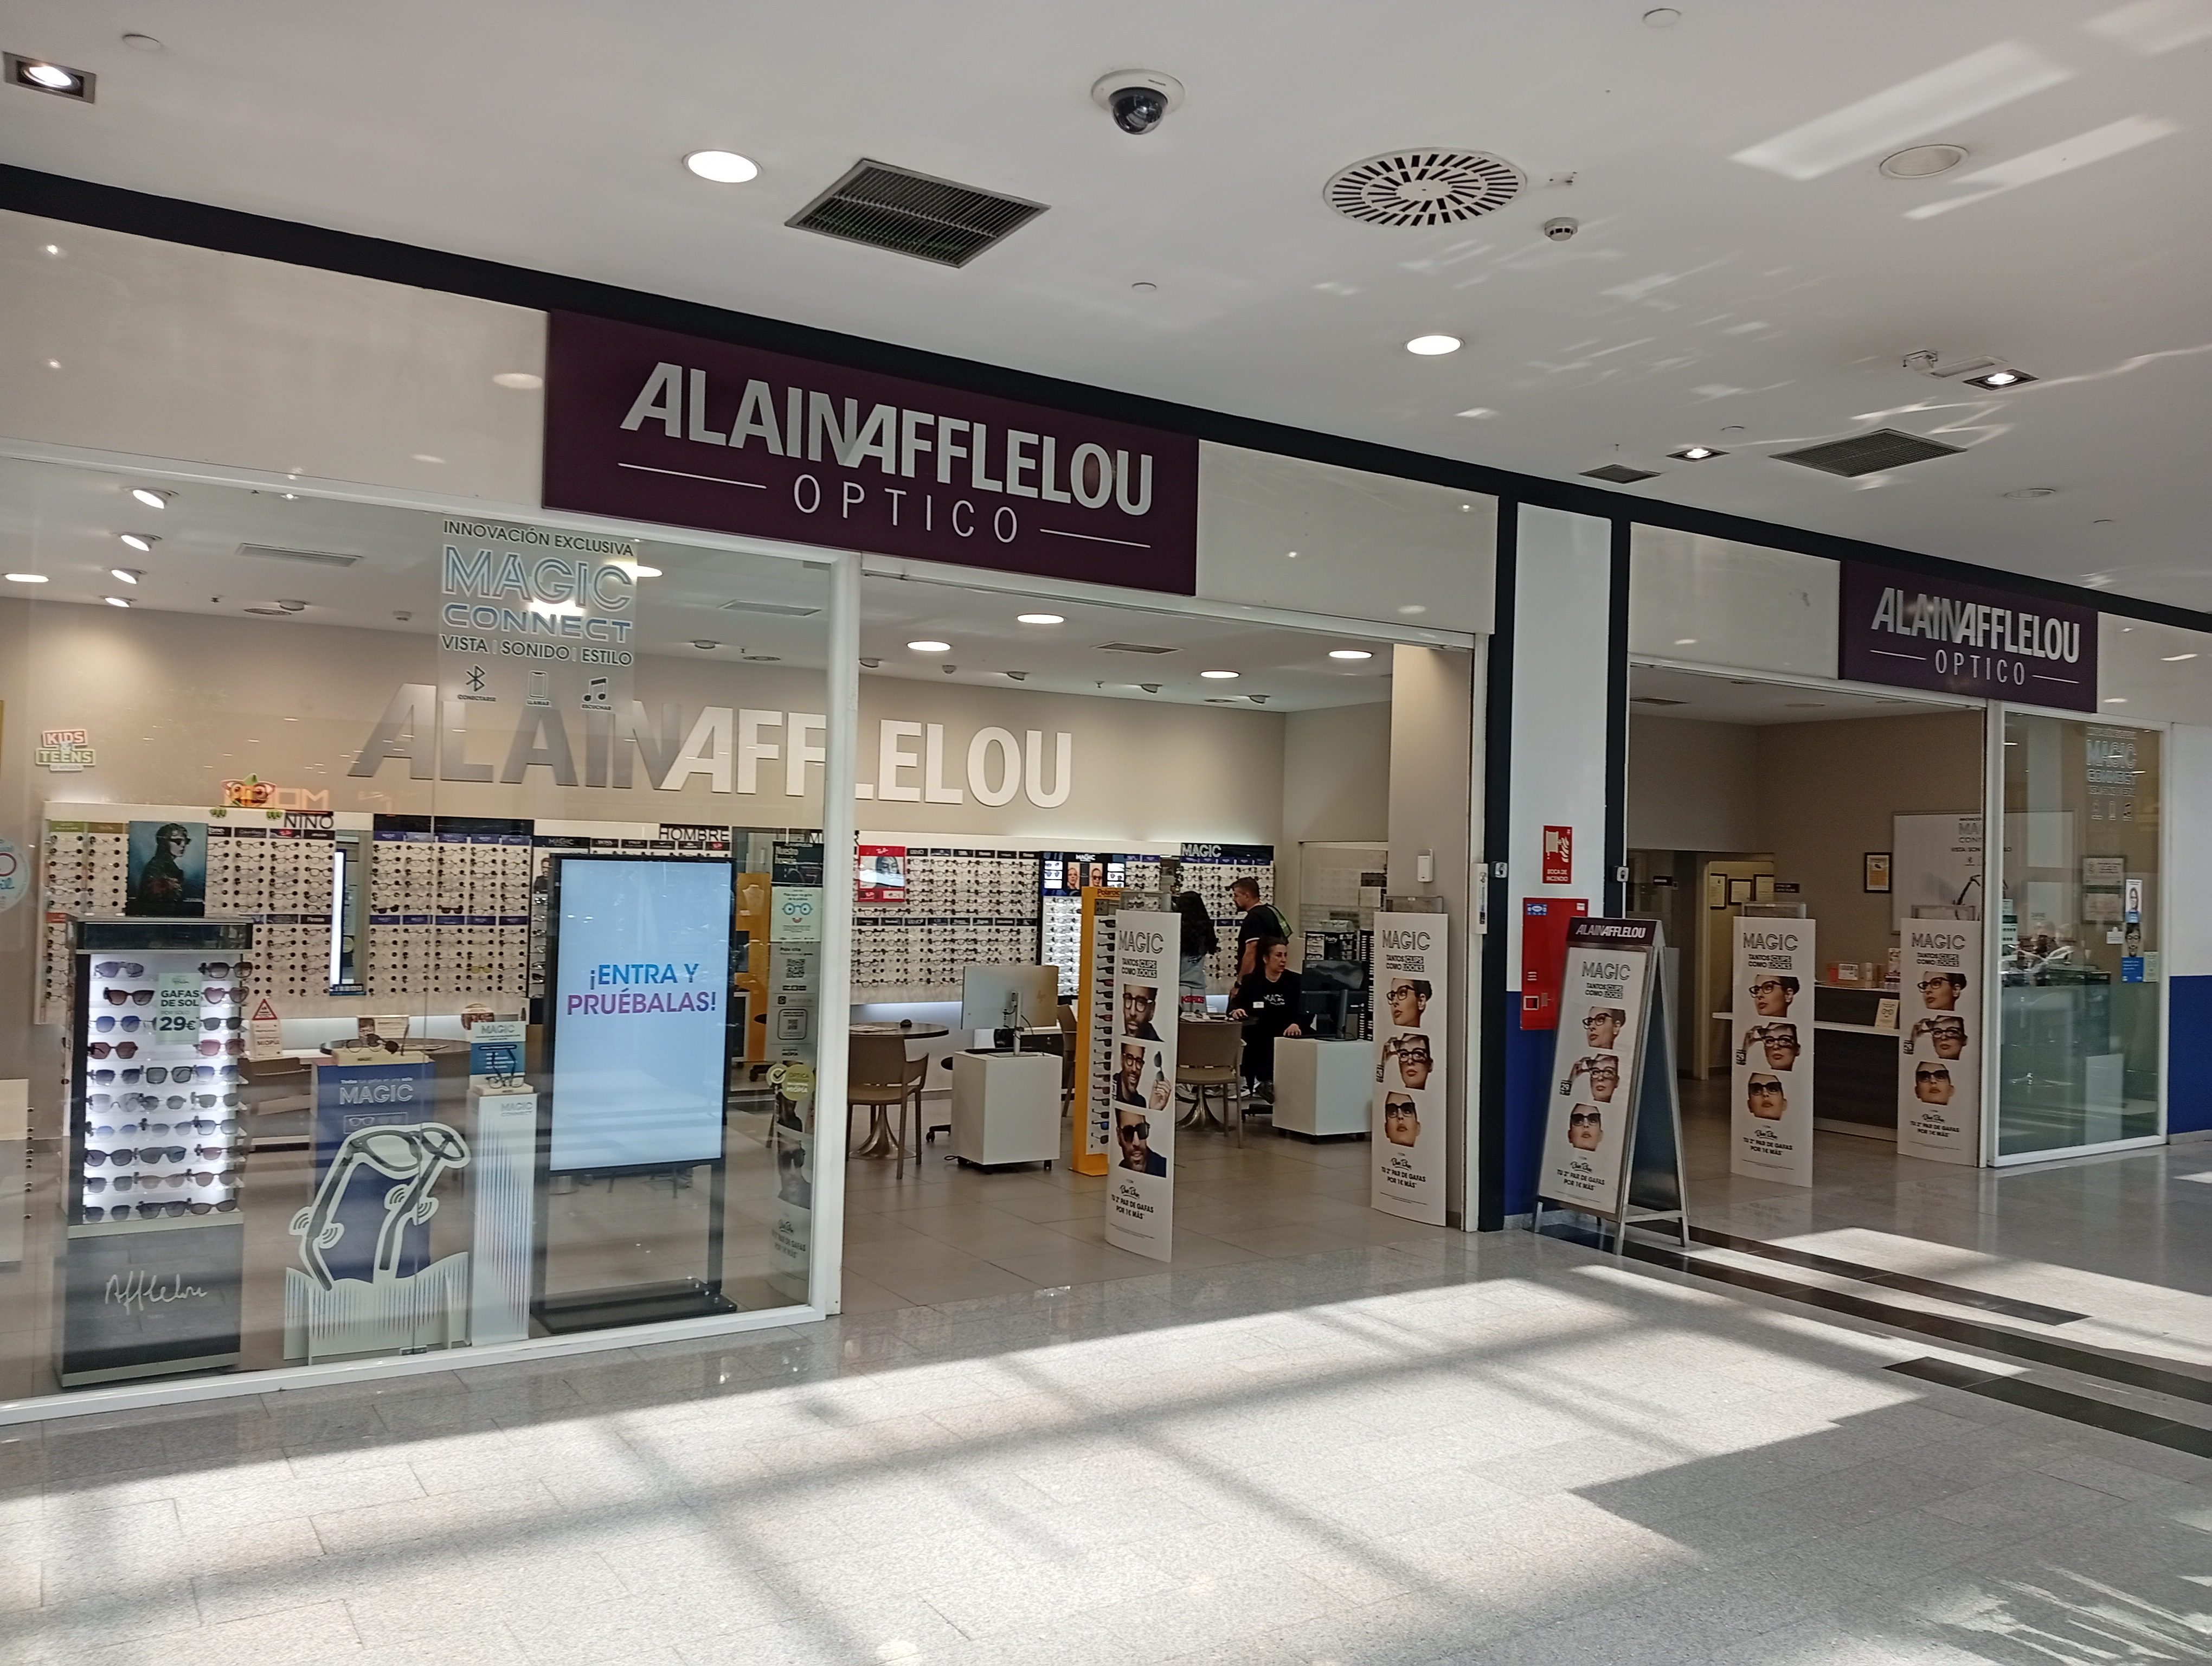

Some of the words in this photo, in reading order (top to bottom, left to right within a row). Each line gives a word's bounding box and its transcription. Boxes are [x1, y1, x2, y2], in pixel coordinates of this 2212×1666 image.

[793, 474, 1018, 543] OPTICO
[443, 520, 550, 546] INNOVACIÓN
[555, 535, 634, 556] EXCLUSIVA
[442, 544, 632, 611] MAGIC
[442, 602, 632, 643] CONNECT
[440, 635, 488, 653] VISTA
[500, 640, 570, 660] SONIDO
[582, 649, 632, 666] ESTILO
[1935, 650, 2025, 685] OPTICO
[47, 732, 84, 745] KIDS
[40, 751, 92, 763] TEENS
[659, 826, 729, 841] HOMBRE
[1181, 844, 1222, 857] MAGIC
[1119, 930, 1163, 953] MAGIC
[1382, 930, 1431, 951] MAGIC
[1742, 932, 1798, 951] MAGIC
[1911, 932, 1966, 950] MAGIC
[1121, 967, 1136, 976] COMO
[1122, 958, 1139, 966] TANTOS
[1581, 961, 1631, 981] MAGIC
[589, 964, 678, 990] ¡ENTRA
[683, 963, 699, 983] Y
[567, 987, 716, 1015] PRUÉBALAS!
[481, 1024, 515, 1034] MAGIC
[340, 1084, 414, 1105] MAGIC
